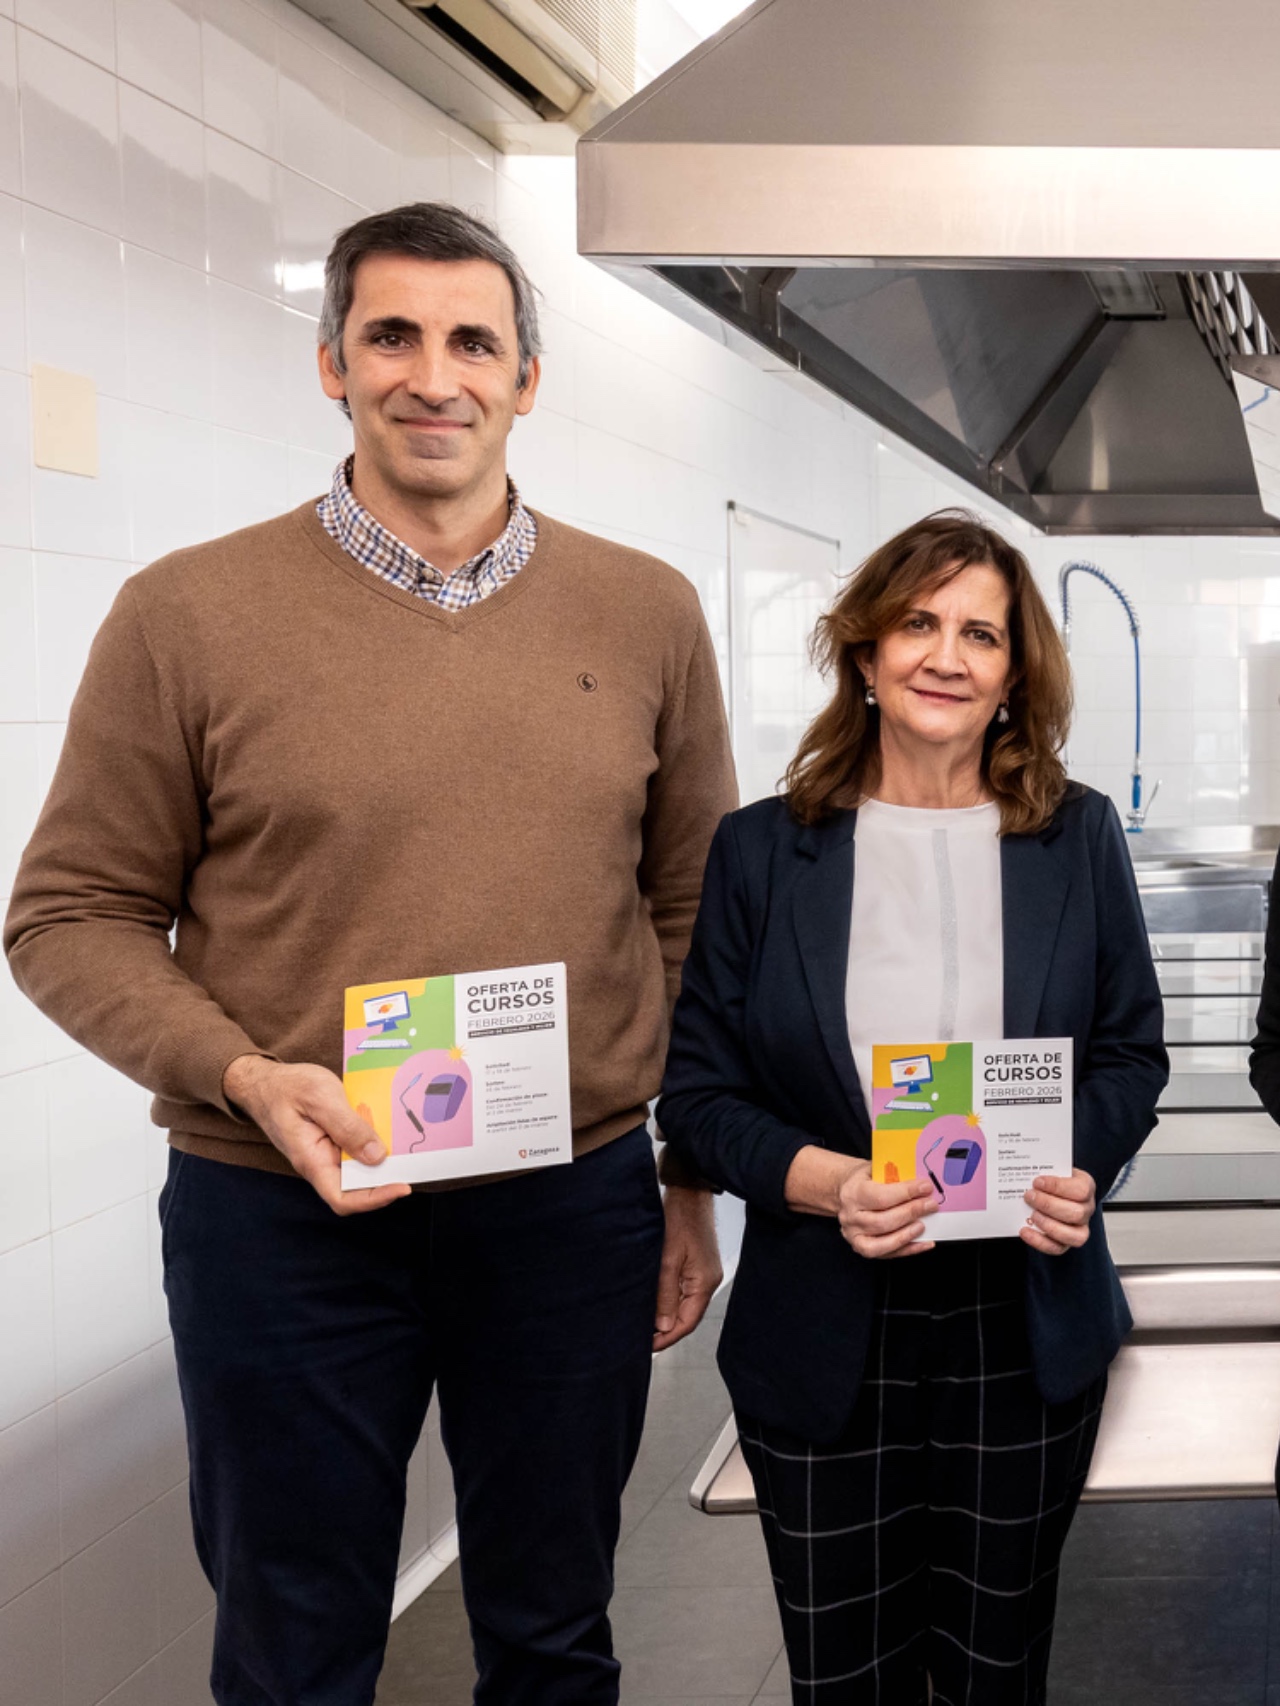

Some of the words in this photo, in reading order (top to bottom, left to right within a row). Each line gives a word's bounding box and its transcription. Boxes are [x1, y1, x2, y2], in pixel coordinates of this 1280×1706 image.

[467, 981, 528, 996] OFERTA
[534, 977, 553, 988] DE
[468, 991, 554, 1013] CURSOS
[468, 1014, 524, 1029] FEBRERO
[527, 1011, 555, 1022] 2026
[984, 1054, 1039, 1065] OFERTA
[1044, 1053, 1062, 1063] DE
[984, 1066, 1062, 1082] CURSOS
[984, 1087, 1034, 1097] FEBRERO
[1037, 1086, 1062, 1095] 2026
